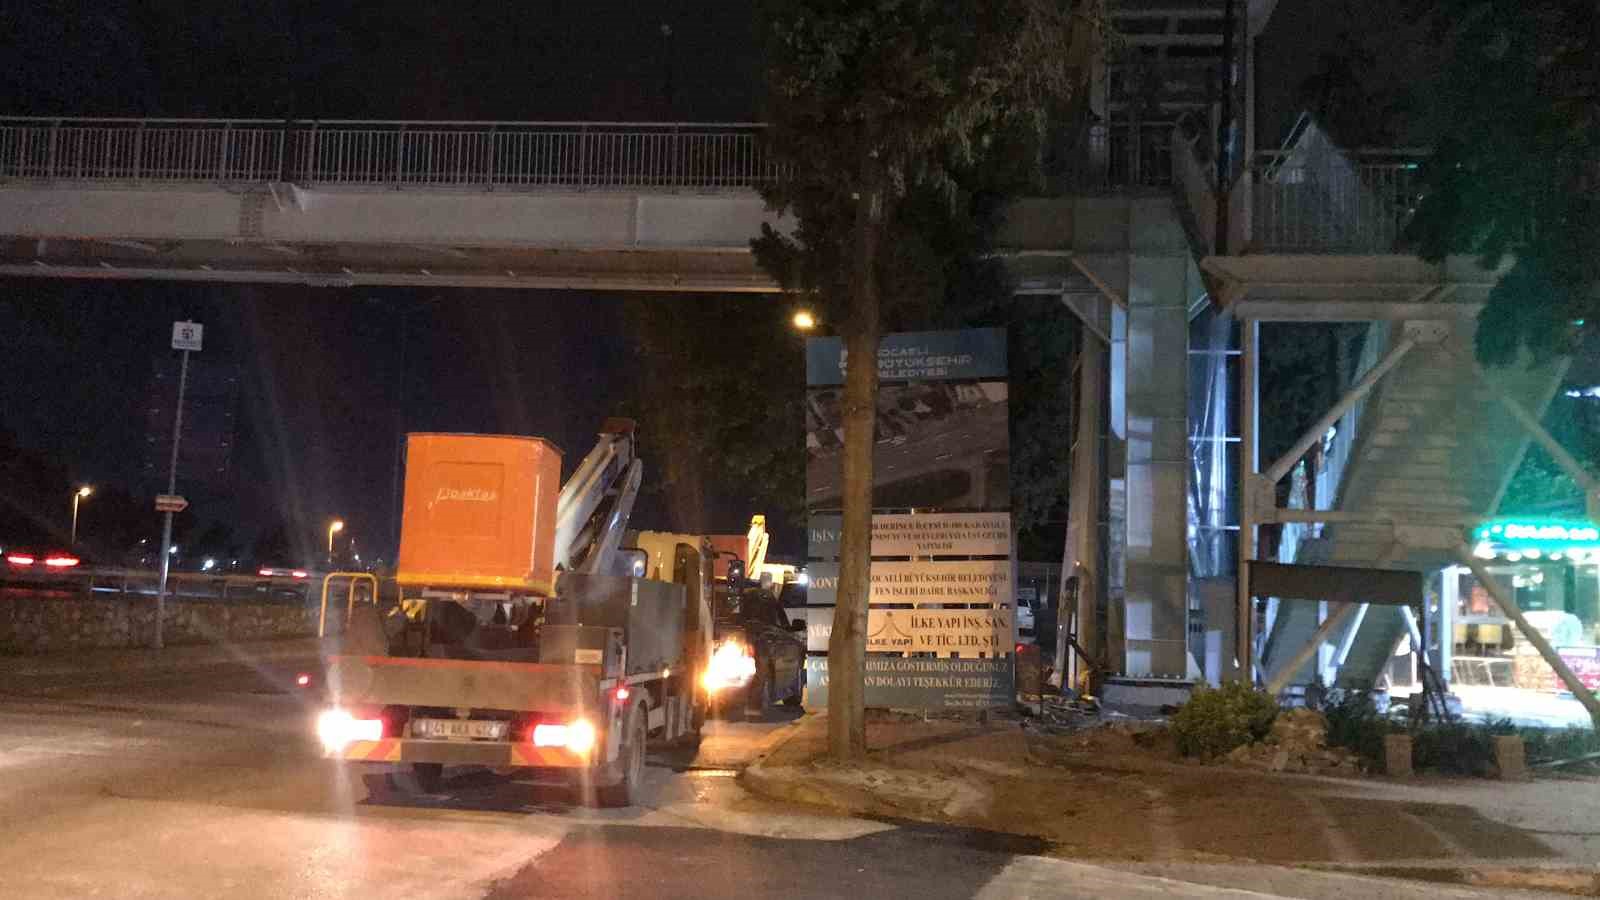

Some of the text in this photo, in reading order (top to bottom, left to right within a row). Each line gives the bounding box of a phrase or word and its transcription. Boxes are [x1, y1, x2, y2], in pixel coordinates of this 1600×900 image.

[871, 573, 902, 583] OCAELİ
[911, 615, 936, 629] İLKE
[937, 616, 961, 629] YAPI
[919, 634, 932, 646] VE
